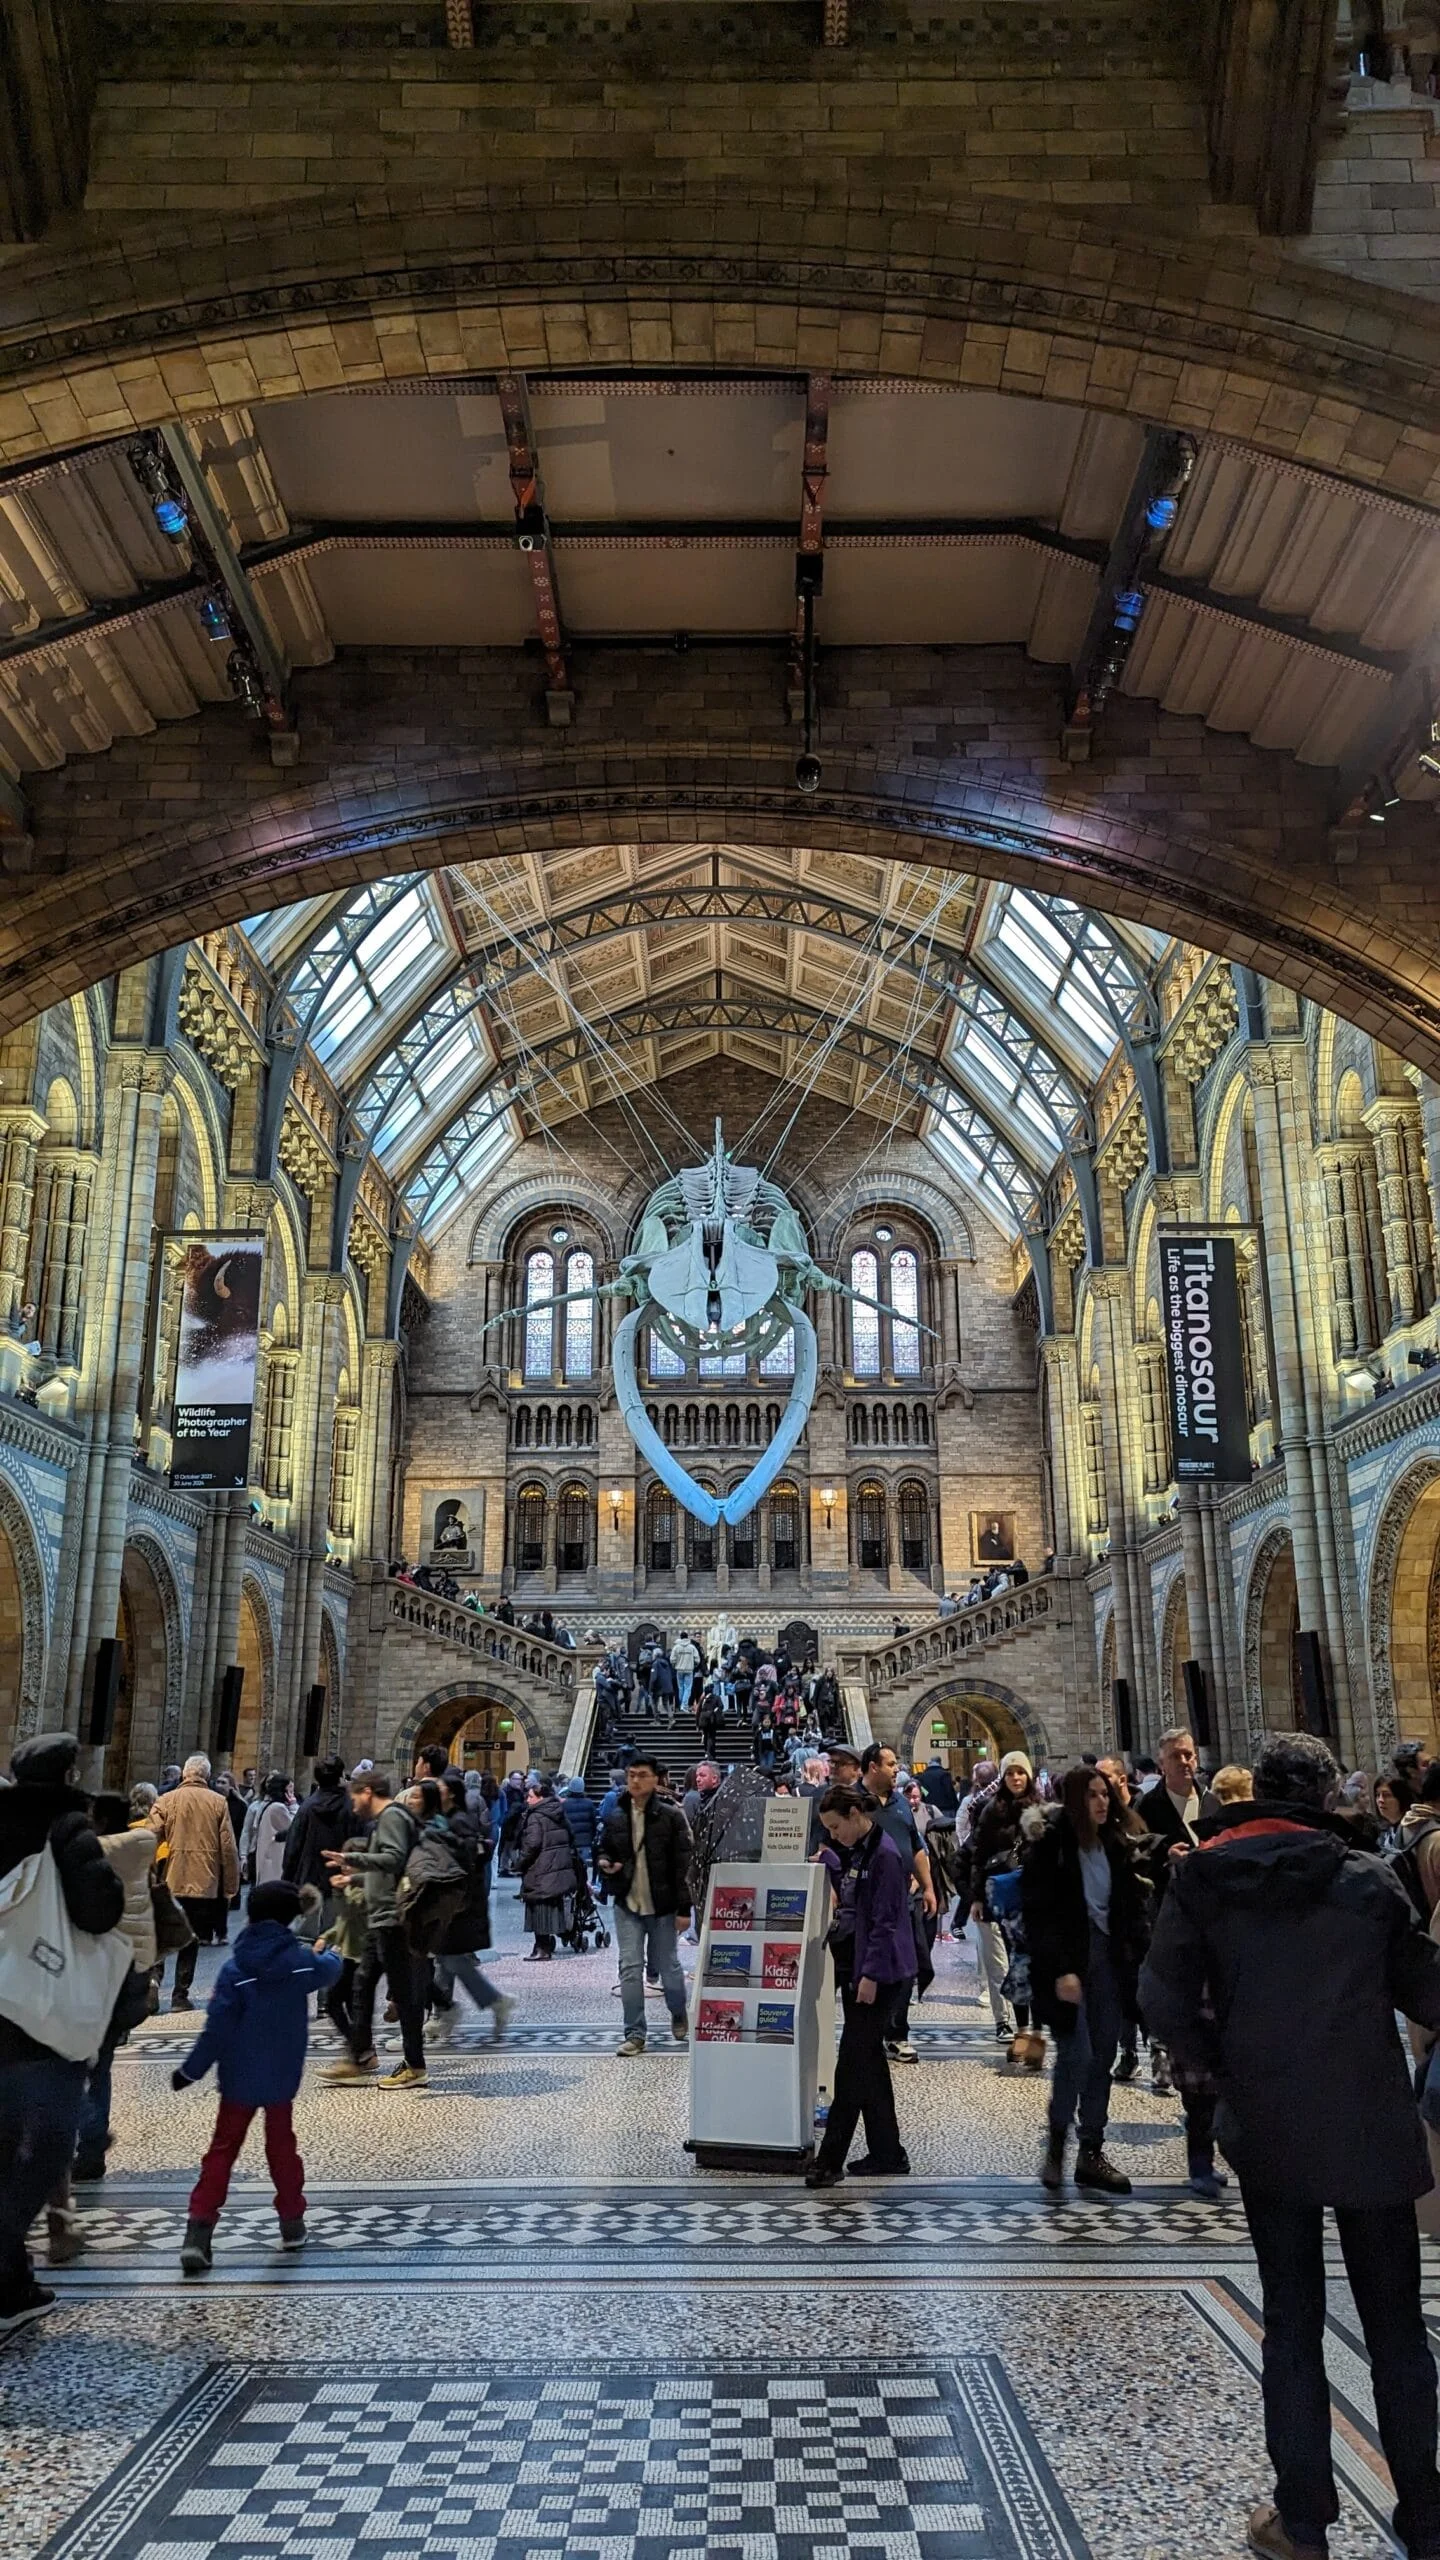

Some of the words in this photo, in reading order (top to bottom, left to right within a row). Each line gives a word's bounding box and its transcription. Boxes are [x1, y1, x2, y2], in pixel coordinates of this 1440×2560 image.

[1167, 1248, 1181, 1273] Life
[1168, 1275, 1180, 1292] as
[1169, 1294, 1183, 1317] the
[1170, 1319, 1187, 1372] biggest
[1183, 1240, 1219, 1444] Titanosaur
[178, 1407, 216, 1417] Wildlife
[1175, 1375, 1189, 1438] dinosaur
[177, 1417, 248, 1428] Photographer
[176, 1428, 189, 1437] of
[189, 1428, 207, 1437] the
[208, 1427, 231, 1437] Year
[771, 1894, 800, 1902] Souvenir
[770, 1901, 790, 1909] guide
[715, 1907, 740, 1919] Kids
[725, 1919, 751, 1931] only
[712, 1949, 741, 1957] Souvenir
[711, 1956, 732, 1964] guide
[764, 1964, 789, 1977] Kids
[759, 2016, 778, 2024] guide
[701, 2022, 727, 2035] Kids
